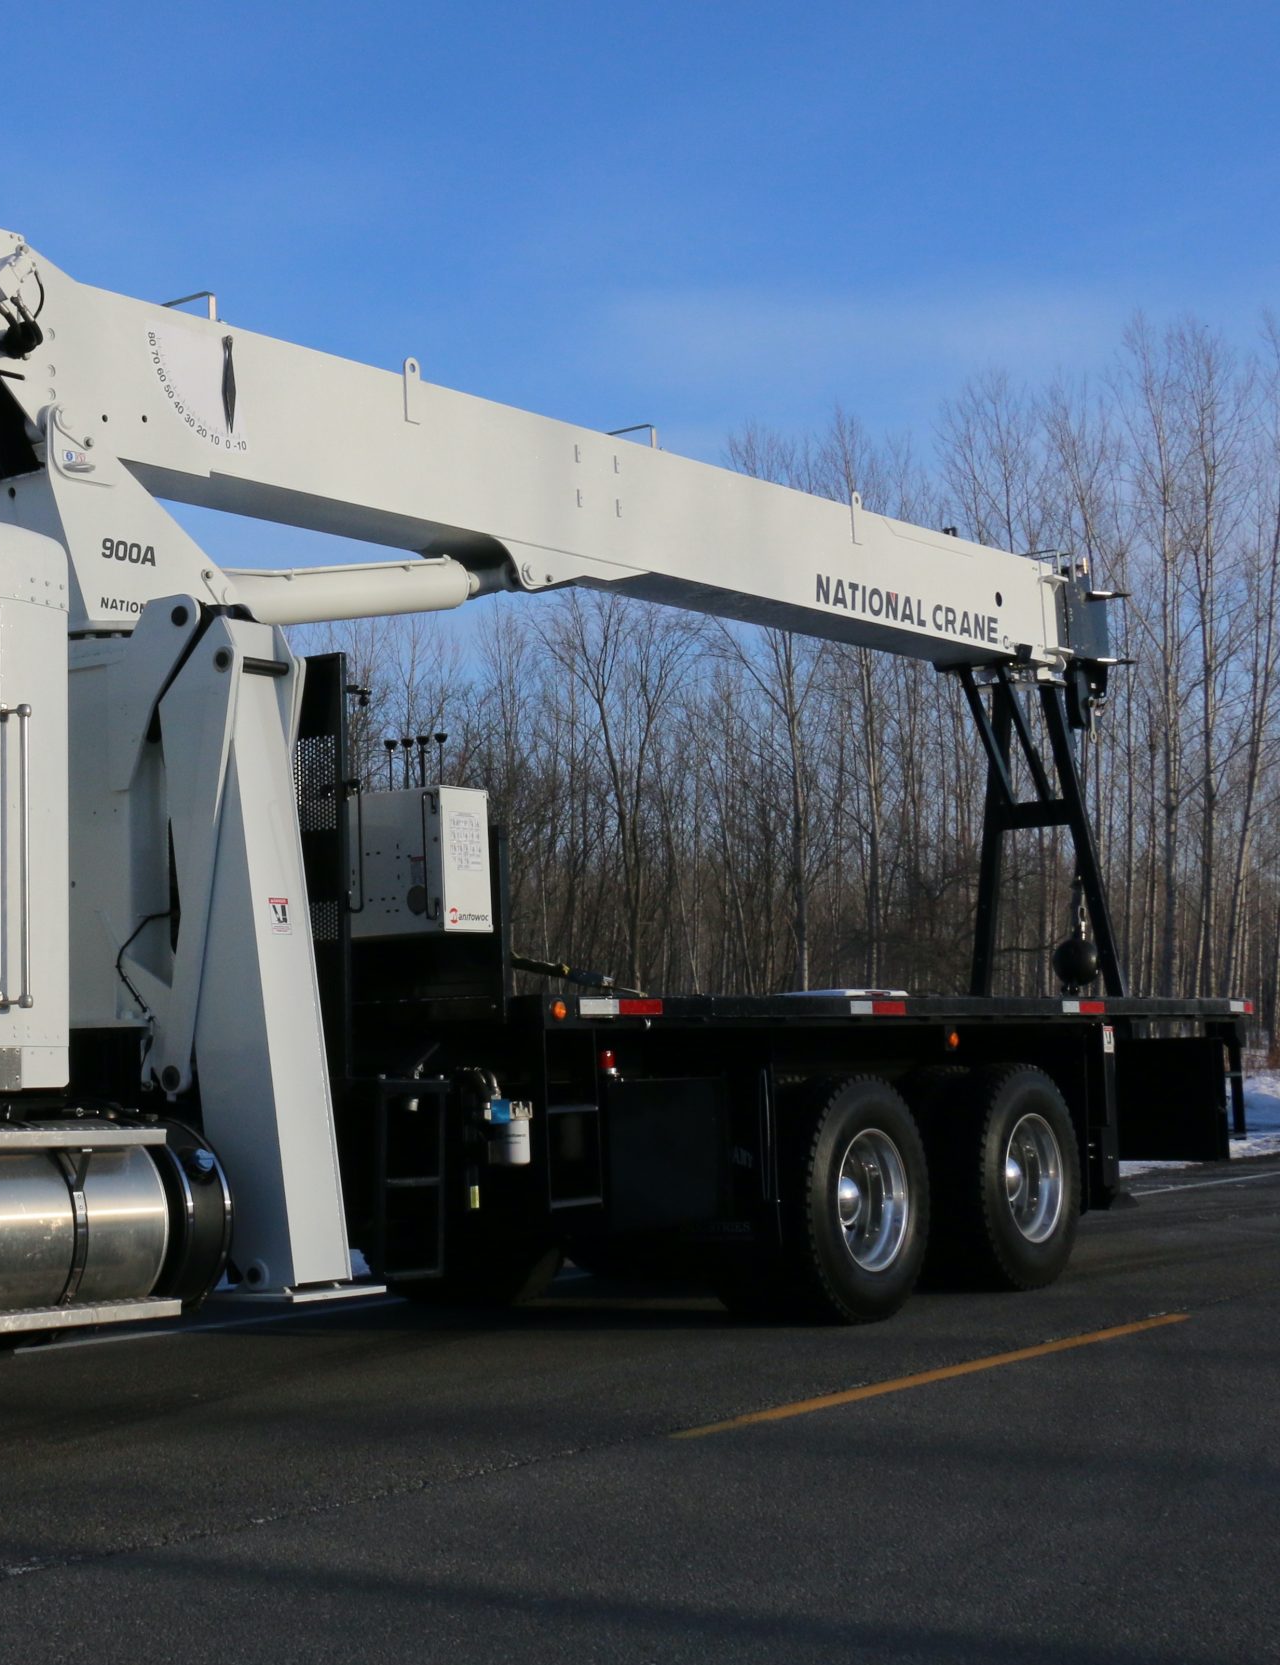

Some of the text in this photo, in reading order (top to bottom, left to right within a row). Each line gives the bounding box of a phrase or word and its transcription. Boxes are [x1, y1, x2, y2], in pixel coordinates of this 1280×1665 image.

[147, 331, 156, 347] 80
[151, 349, 161, 365] 70
[156, 367, 166, 383] 60
[163, 384, 174, 399] 50
[173, 400, 184, 415] 40
[184, 414, 195, 428] 30
[196, 425, 208, 438] 20
[210, 433, 220, 446] 10
[225, 439, 231, 449] 0
[101, 537, 157, 567] 900A
[815, 573, 999, 644] NATIONAL CRANE
